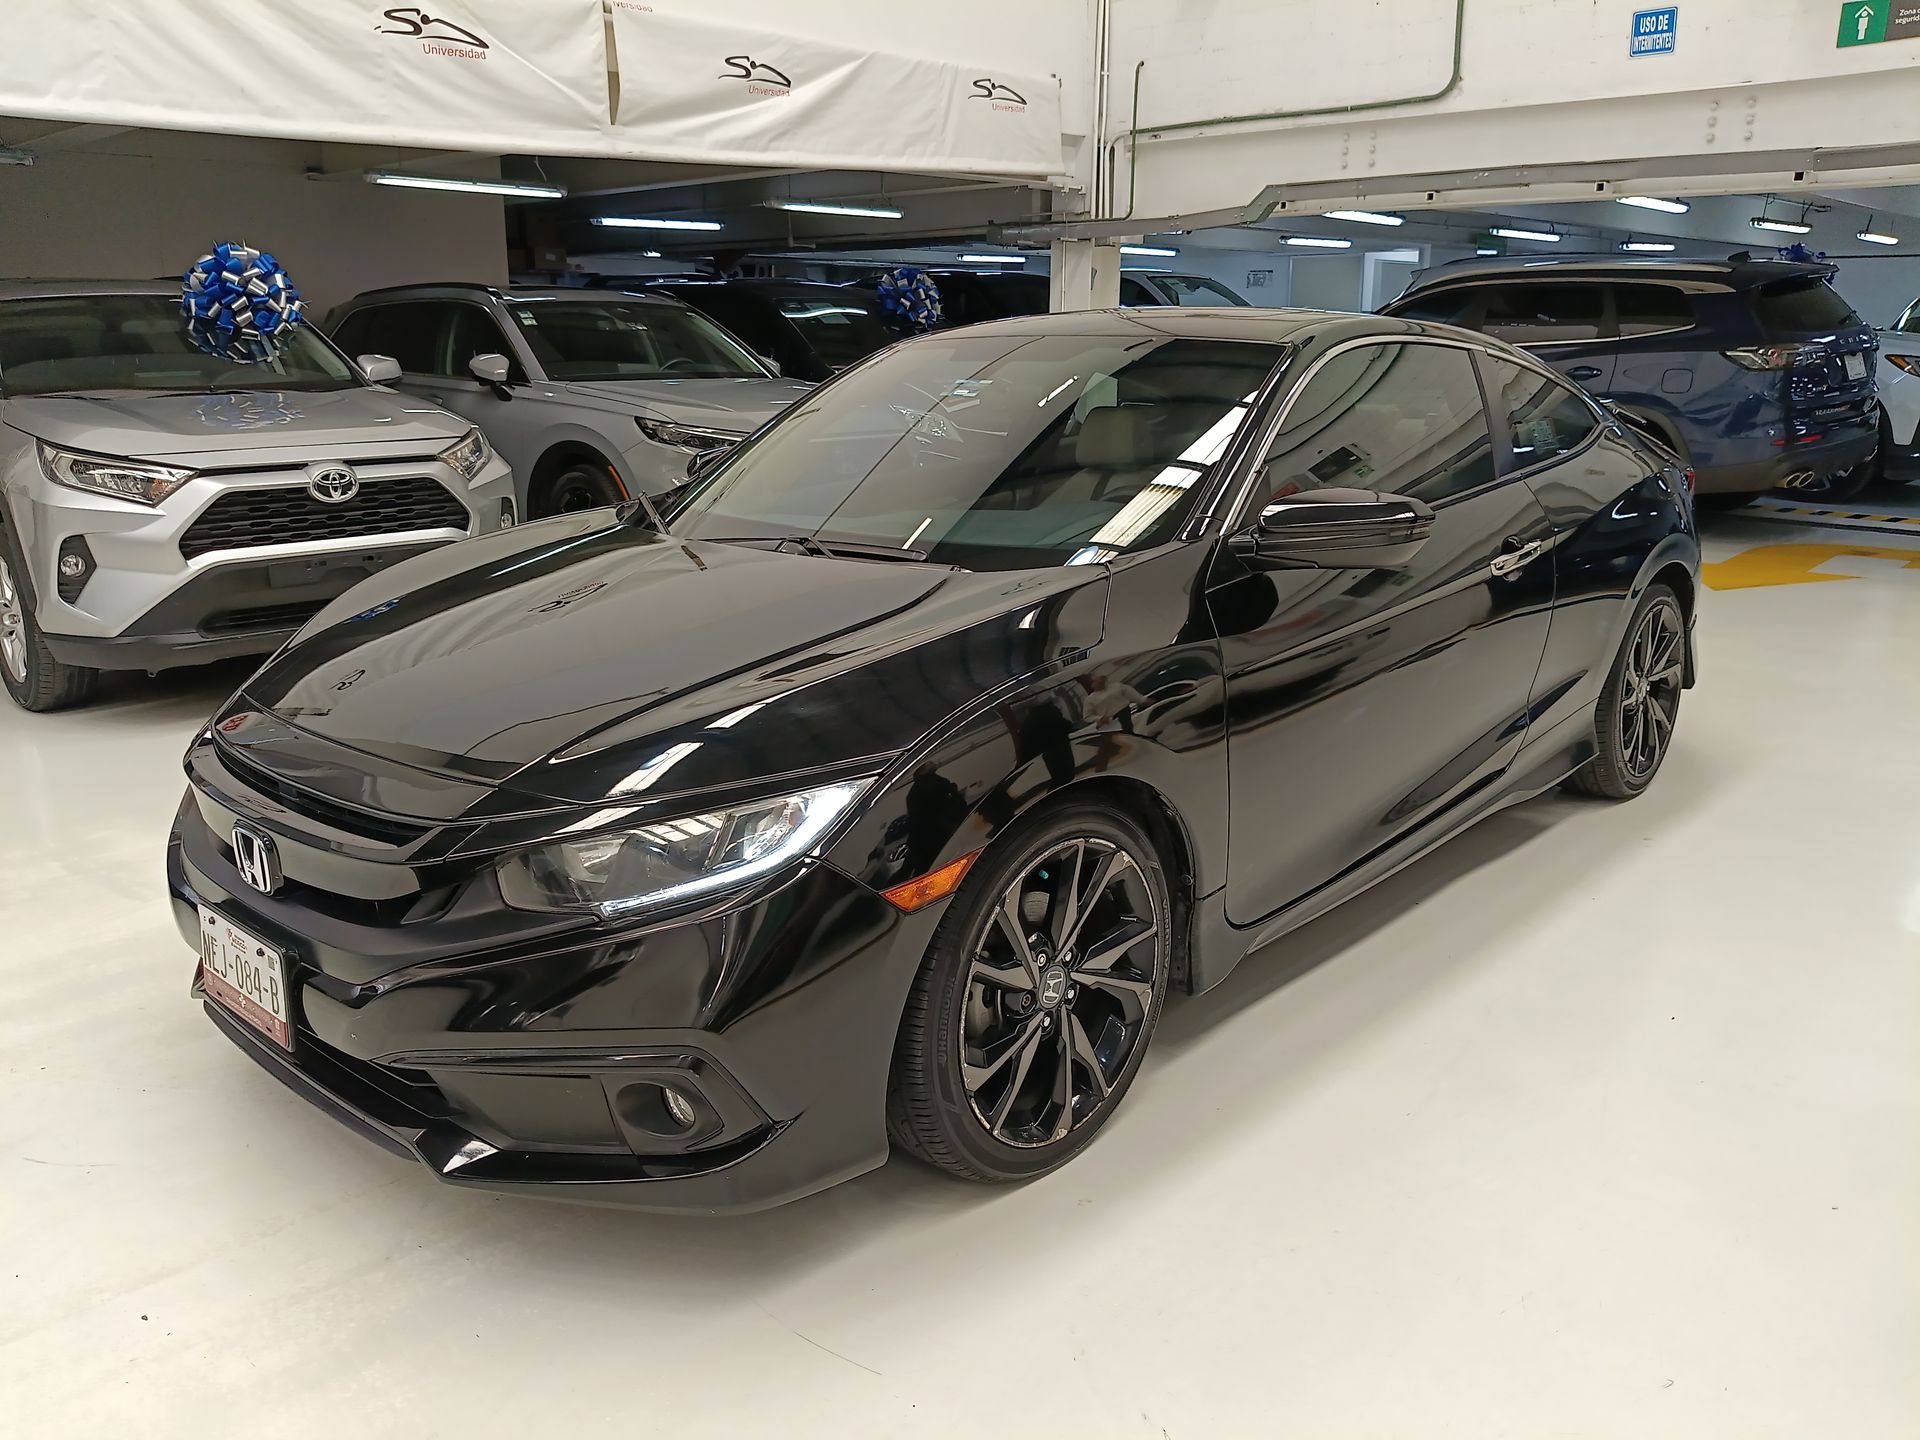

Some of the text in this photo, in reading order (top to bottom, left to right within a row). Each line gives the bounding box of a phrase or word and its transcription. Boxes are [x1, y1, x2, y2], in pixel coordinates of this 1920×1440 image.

[1640, 14, 1670, 34] USO DE
[422, 43, 487, 60] Universidad
[748, 84, 791, 97] Universidad
[202, 930, 280, 1015] NEJ-084-B
